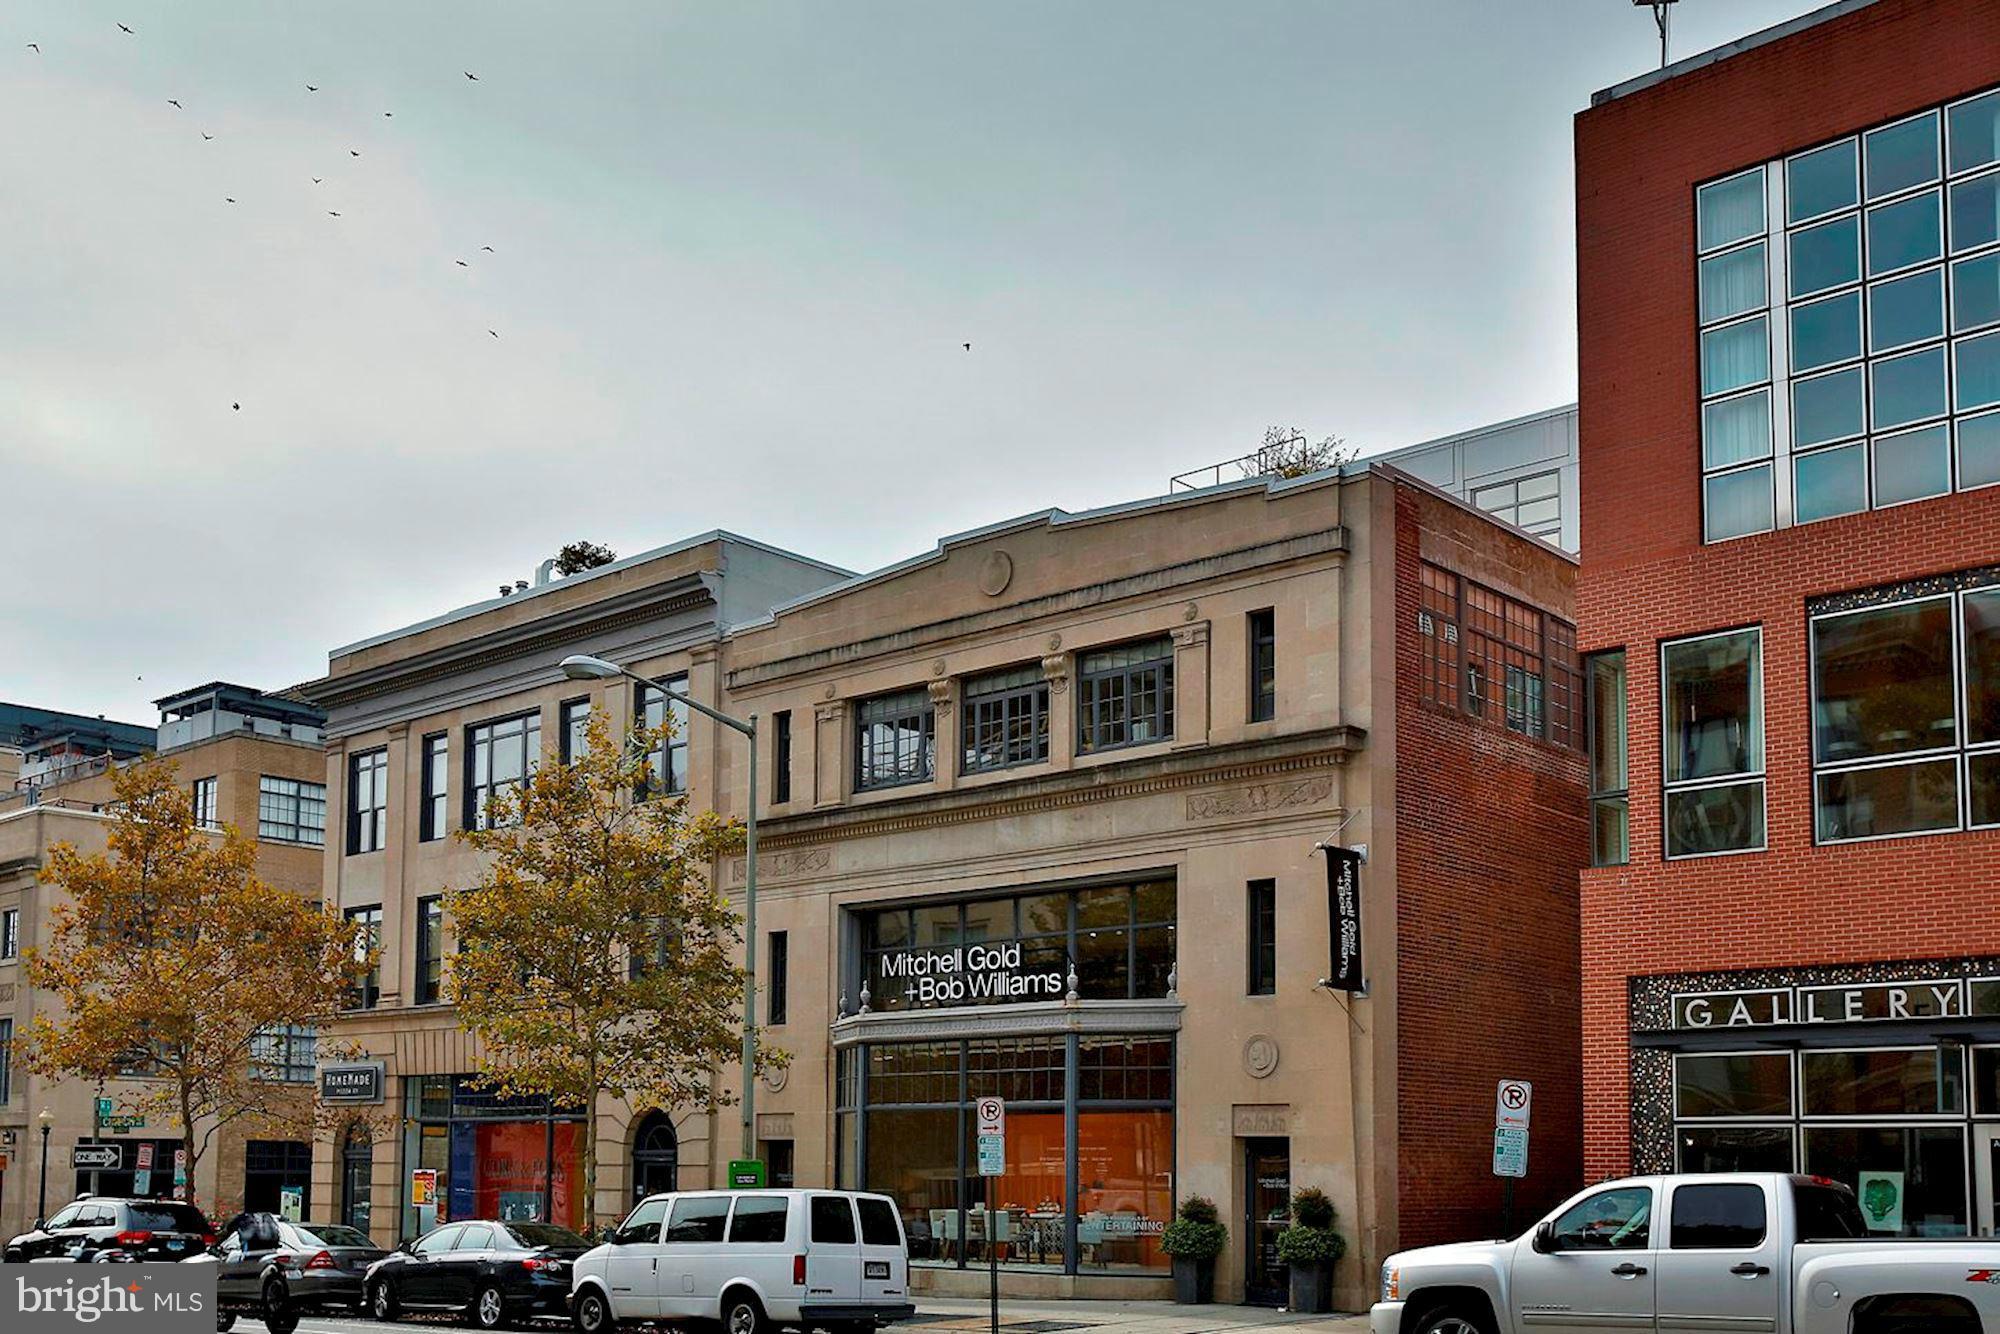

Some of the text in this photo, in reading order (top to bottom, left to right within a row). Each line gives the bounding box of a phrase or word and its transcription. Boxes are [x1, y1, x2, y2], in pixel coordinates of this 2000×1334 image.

[881, 942, 1021, 978] Mitchell Gold
[904, 971, 1062, 1001] +Bob Williams
[1684, 985, 1958, 1028] GALLERY
[75, 1152, 112, 1161] ONE WAY
